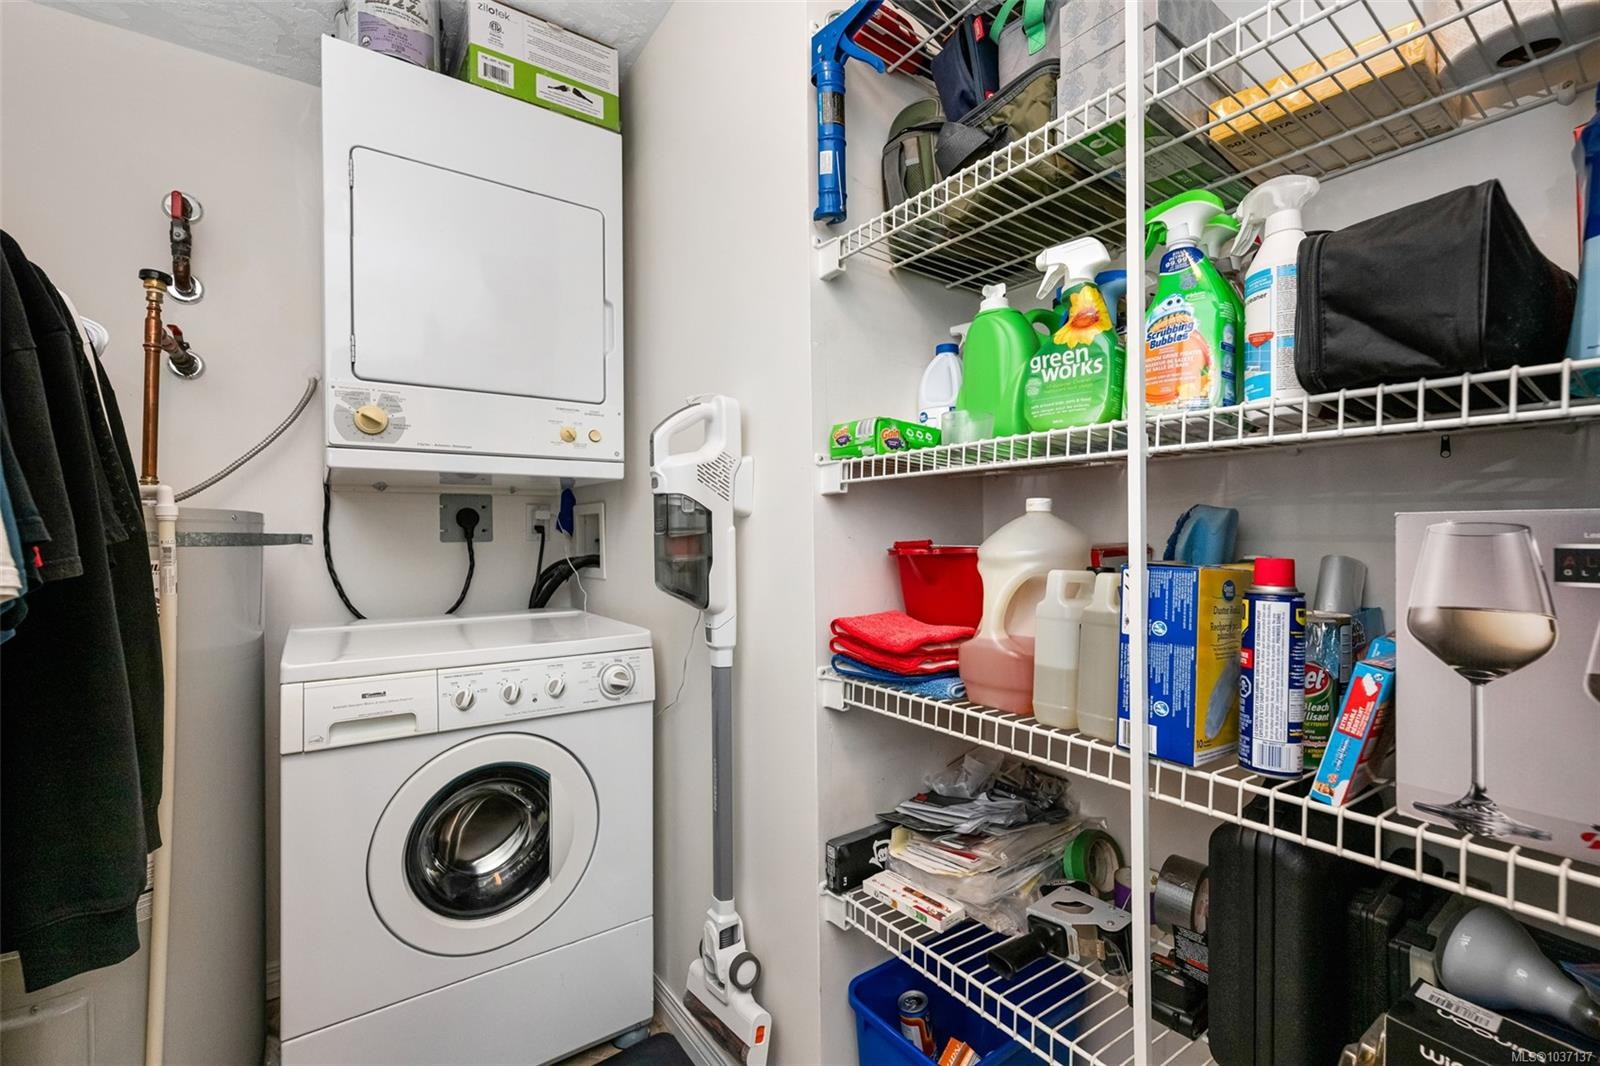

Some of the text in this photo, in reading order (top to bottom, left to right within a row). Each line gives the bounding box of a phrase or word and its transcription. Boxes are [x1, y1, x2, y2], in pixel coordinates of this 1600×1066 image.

[1147, 322, 1195, 341] Scrubbing
[1150, 332, 1188, 349] Bubbles
[1030, 347, 1089, 374] green
[1041, 357, 1103, 383] works
[1304, 711, 1329, 721] lisant
